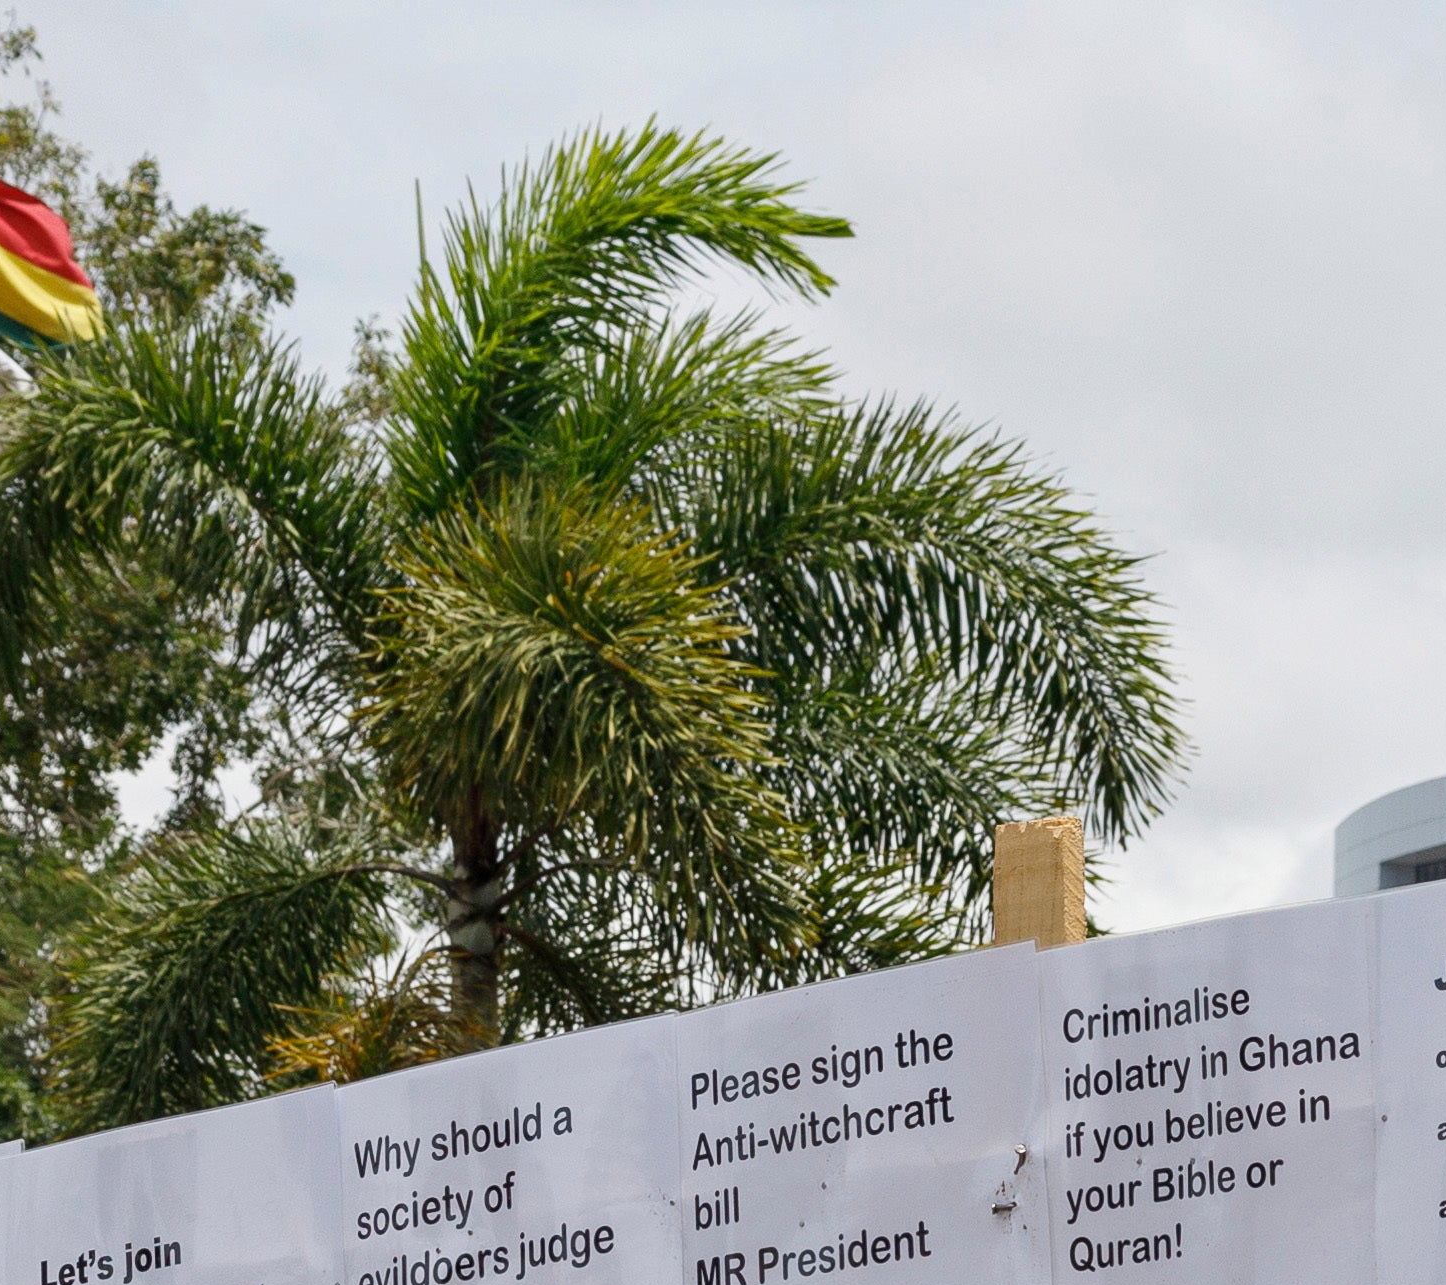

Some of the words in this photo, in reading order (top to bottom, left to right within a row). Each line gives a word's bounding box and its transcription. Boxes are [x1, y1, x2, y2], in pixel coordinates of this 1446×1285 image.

[1062, 987, 1250, 1044] Criminalise
[691, 1062, 801, 1111] Please
[811, 1045, 884, 1089] sign
[894, 1028, 954, 1069] the
[1065, 1054, 1191, 1102] idolatry
[1201, 1050, 1228, 1080] in
[1238, 1032, 1361, 1073] Ghana
[354, 1134, 421, 1179] Why
[431, 1101, 542, 1162] should
[553, 1106, 573, 1136] a
[692, 1086, 955, 1171] Anti-witchcraft
[1065, 1121, 1086, 1159] if
[1093, 1120, 1154, 1164] you
[1165, 1100, 1287, 1144] believe
[1298, 1088, 1331, 1124] in
[357, 1184, 474, 1240] society
[484, 1170, 516, 1214] of
[694, 1186, 740, 1231] bill
[1066, 1180, 1143, 1225] your
[1152, 1157, 1236, 1203] Bible
[1246, 1158, 1284, 1189] or
[122, 1236, 182, 1285] join
[515, 1222, 615, 1281] judge
[758, 1220, 932, 1285] President
[1069, 1222, 1183, 1273] Quran!
